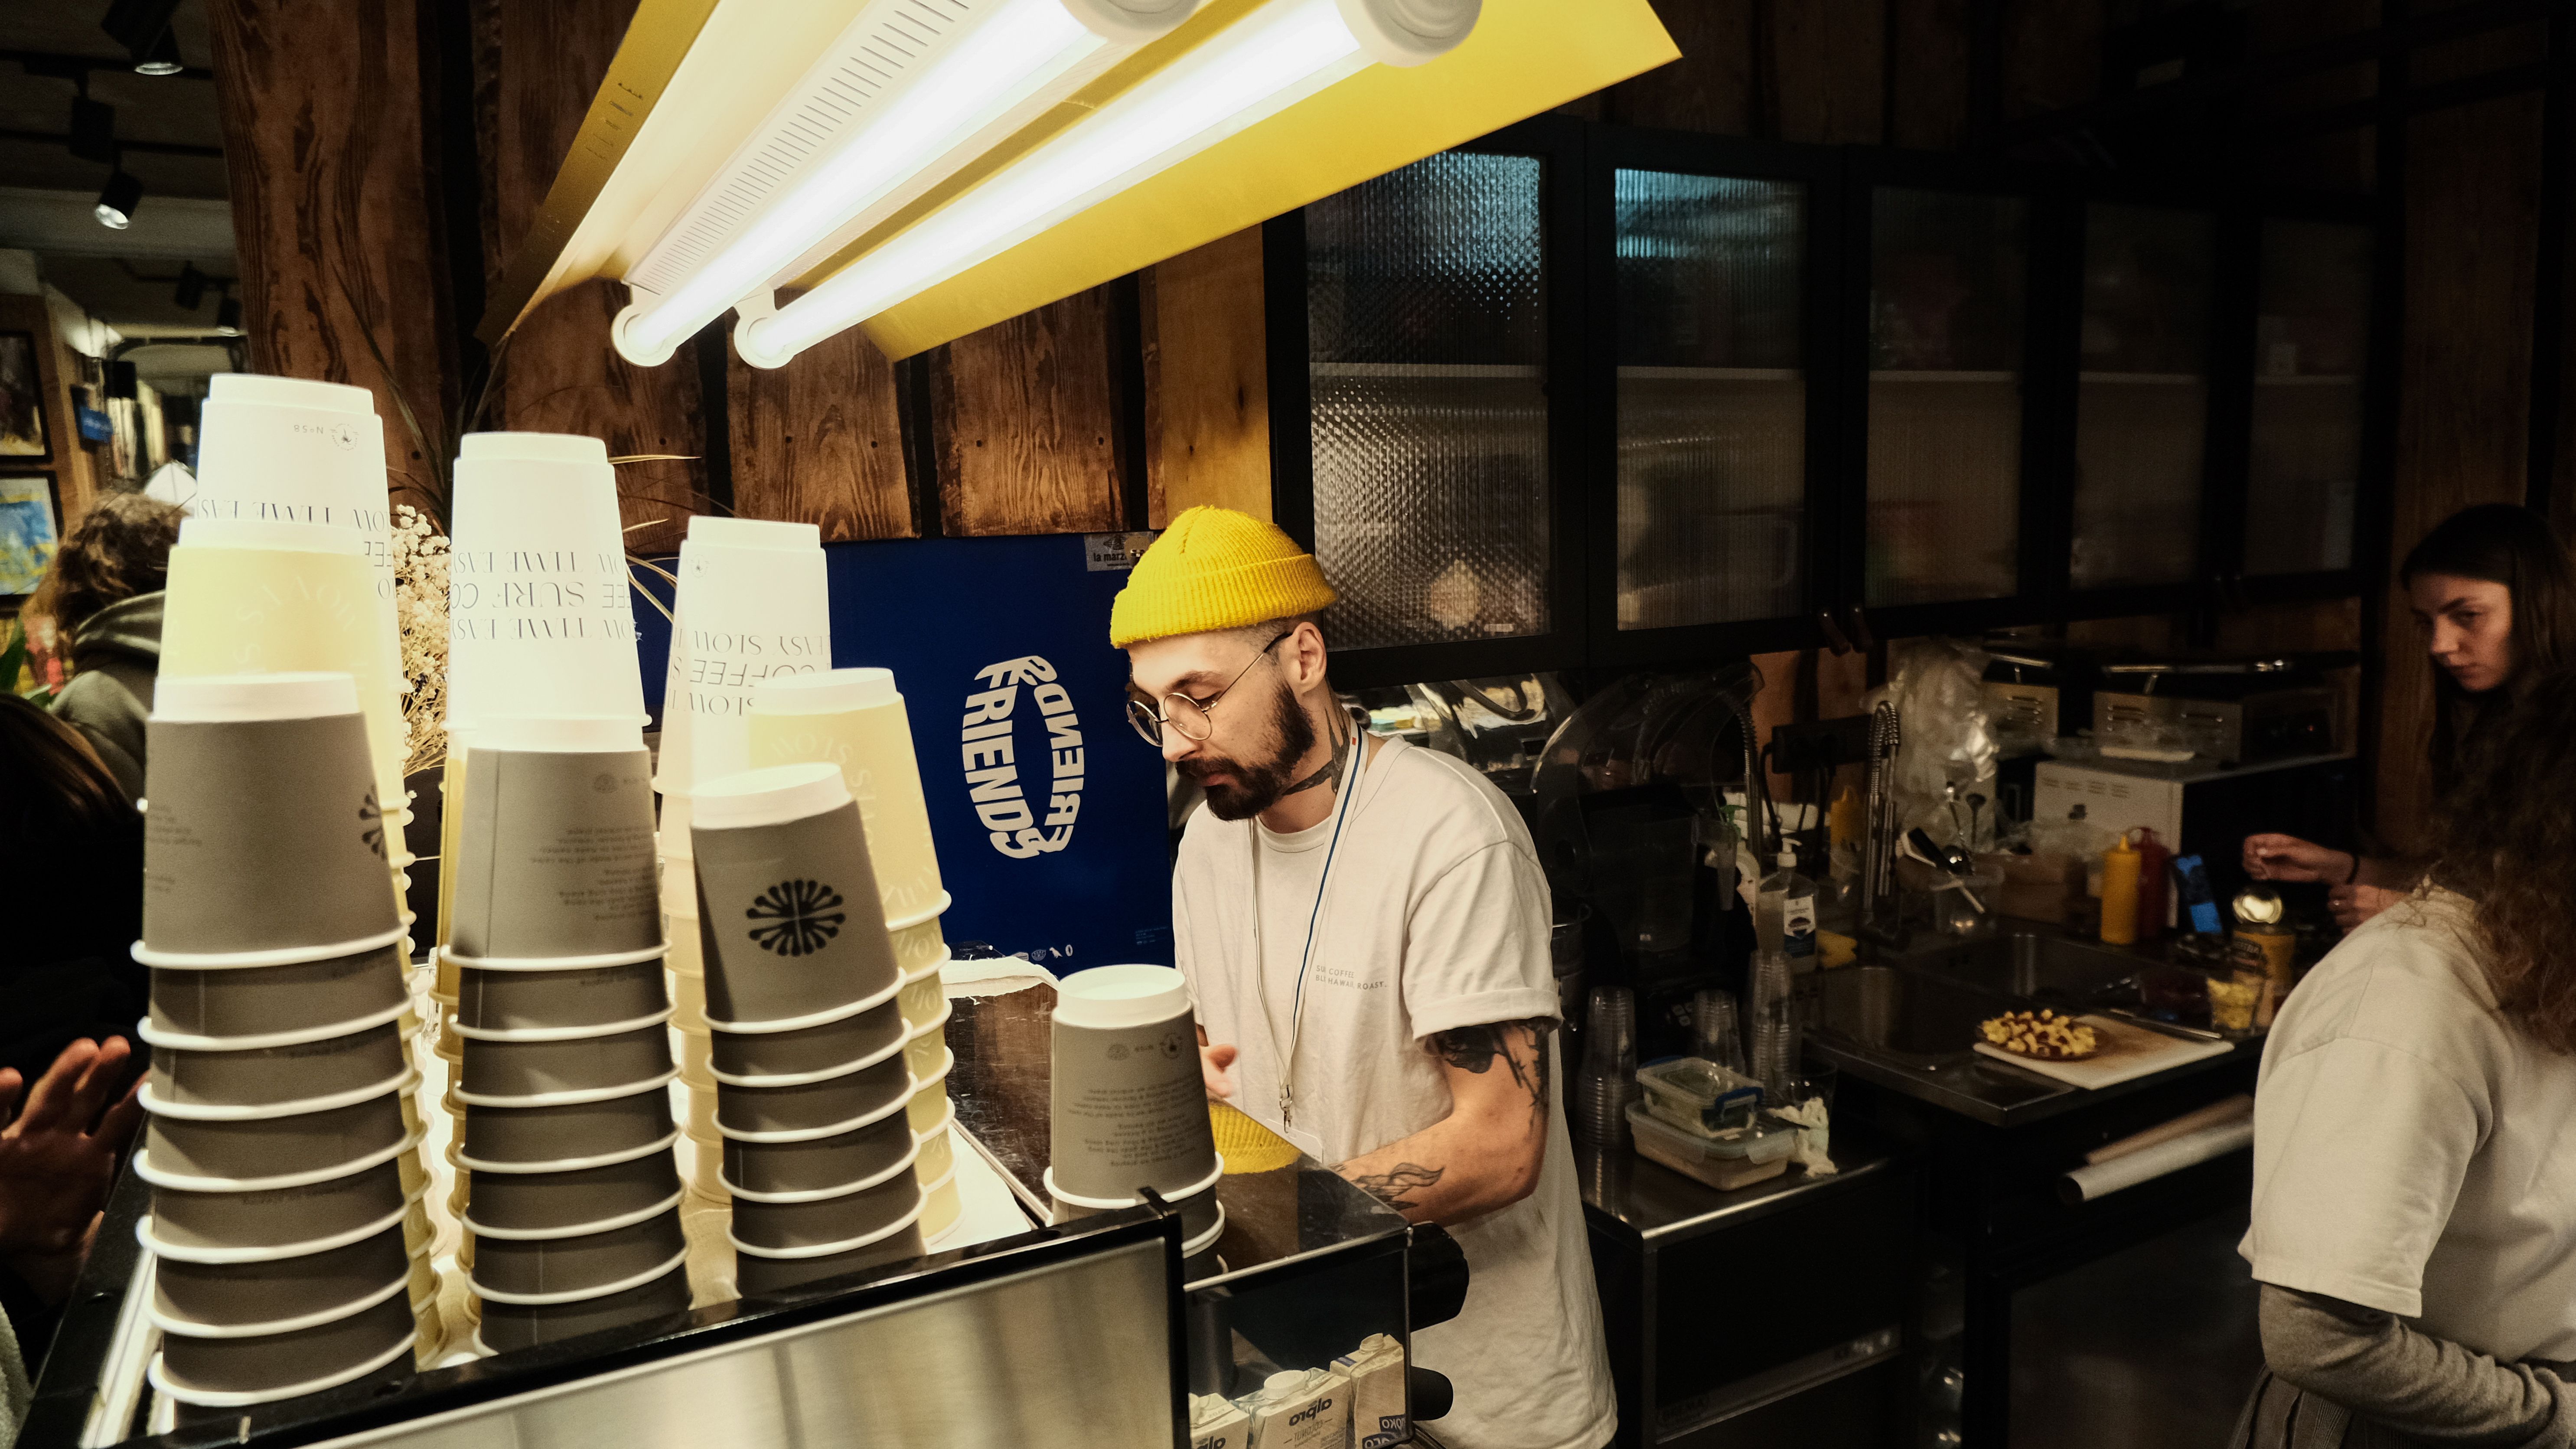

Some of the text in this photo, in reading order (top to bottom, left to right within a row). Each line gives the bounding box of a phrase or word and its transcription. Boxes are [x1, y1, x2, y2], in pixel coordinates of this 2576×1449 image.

[505, 551, 584, 573] TIME
[1093, 552, 1128, 562] la marz
[492, 581, 585, 608] SURF
[508, 617, 593, 640] TIME
[691, 630, 762, 656] SLOW
[962, 657, 1040, 859] FRIENDS
[1329, 968, 1355, 979] COFFEE
